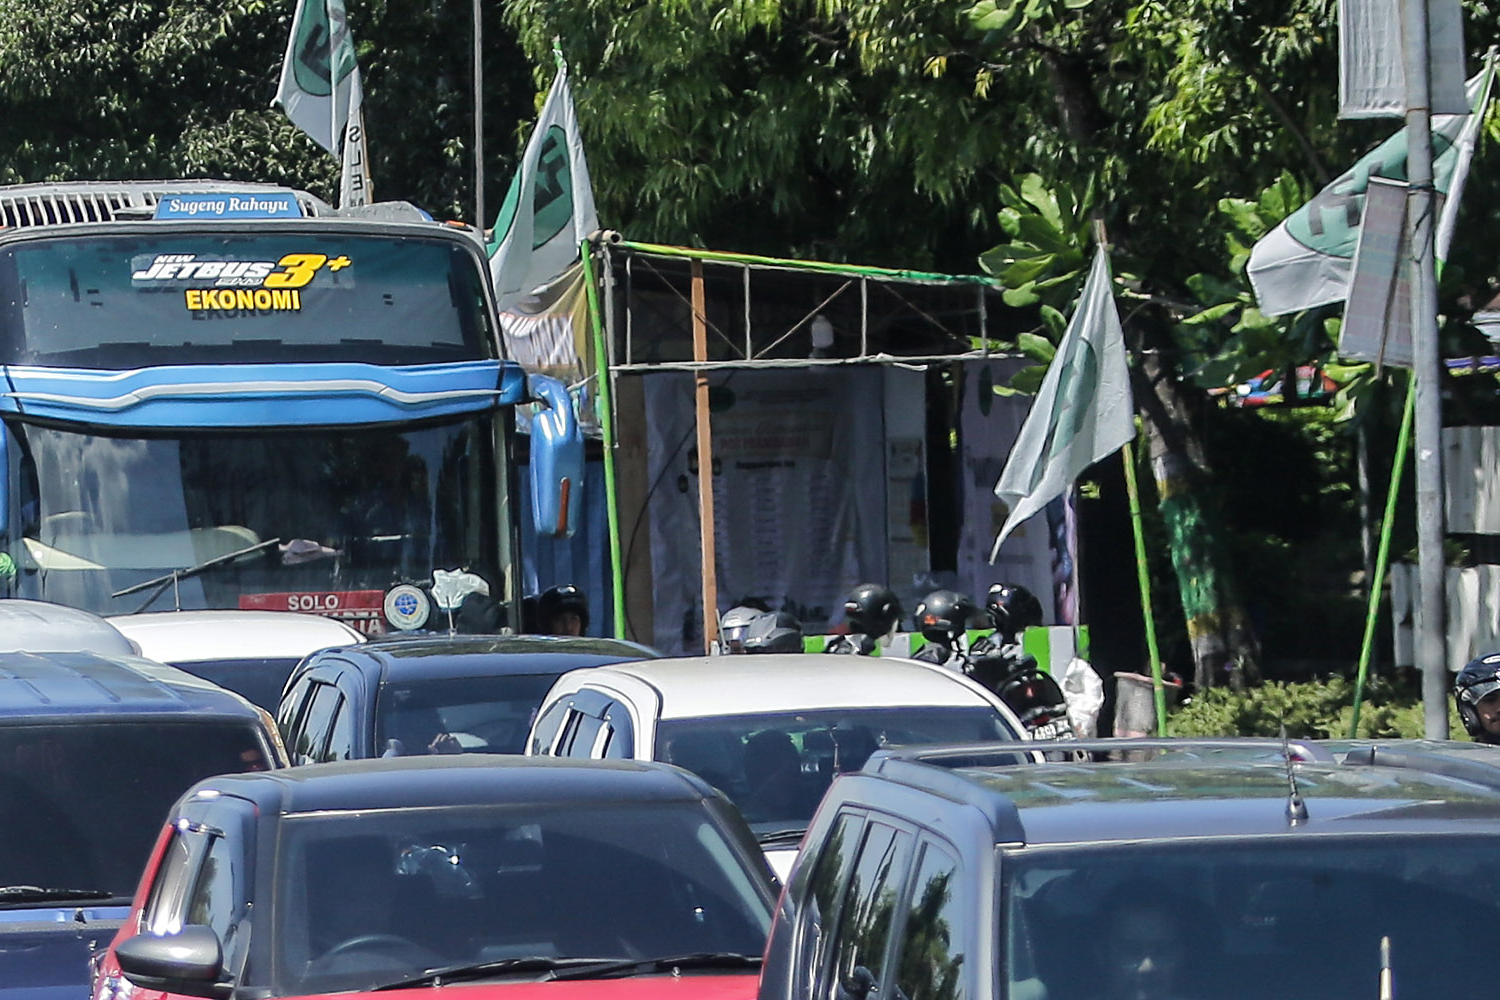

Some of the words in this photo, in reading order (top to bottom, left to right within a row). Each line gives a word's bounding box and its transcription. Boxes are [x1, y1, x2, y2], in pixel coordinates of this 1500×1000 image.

[169, 199, 225, 215] Sugeng
[228, 197, 289, 214] Rahayu
[153, 255, 196, 264] NEW
[132, 262, 276, 280] JETBUS
[185, 289, 301, 310] EKONOMI
[287, 595, 339, 611] SOLO
